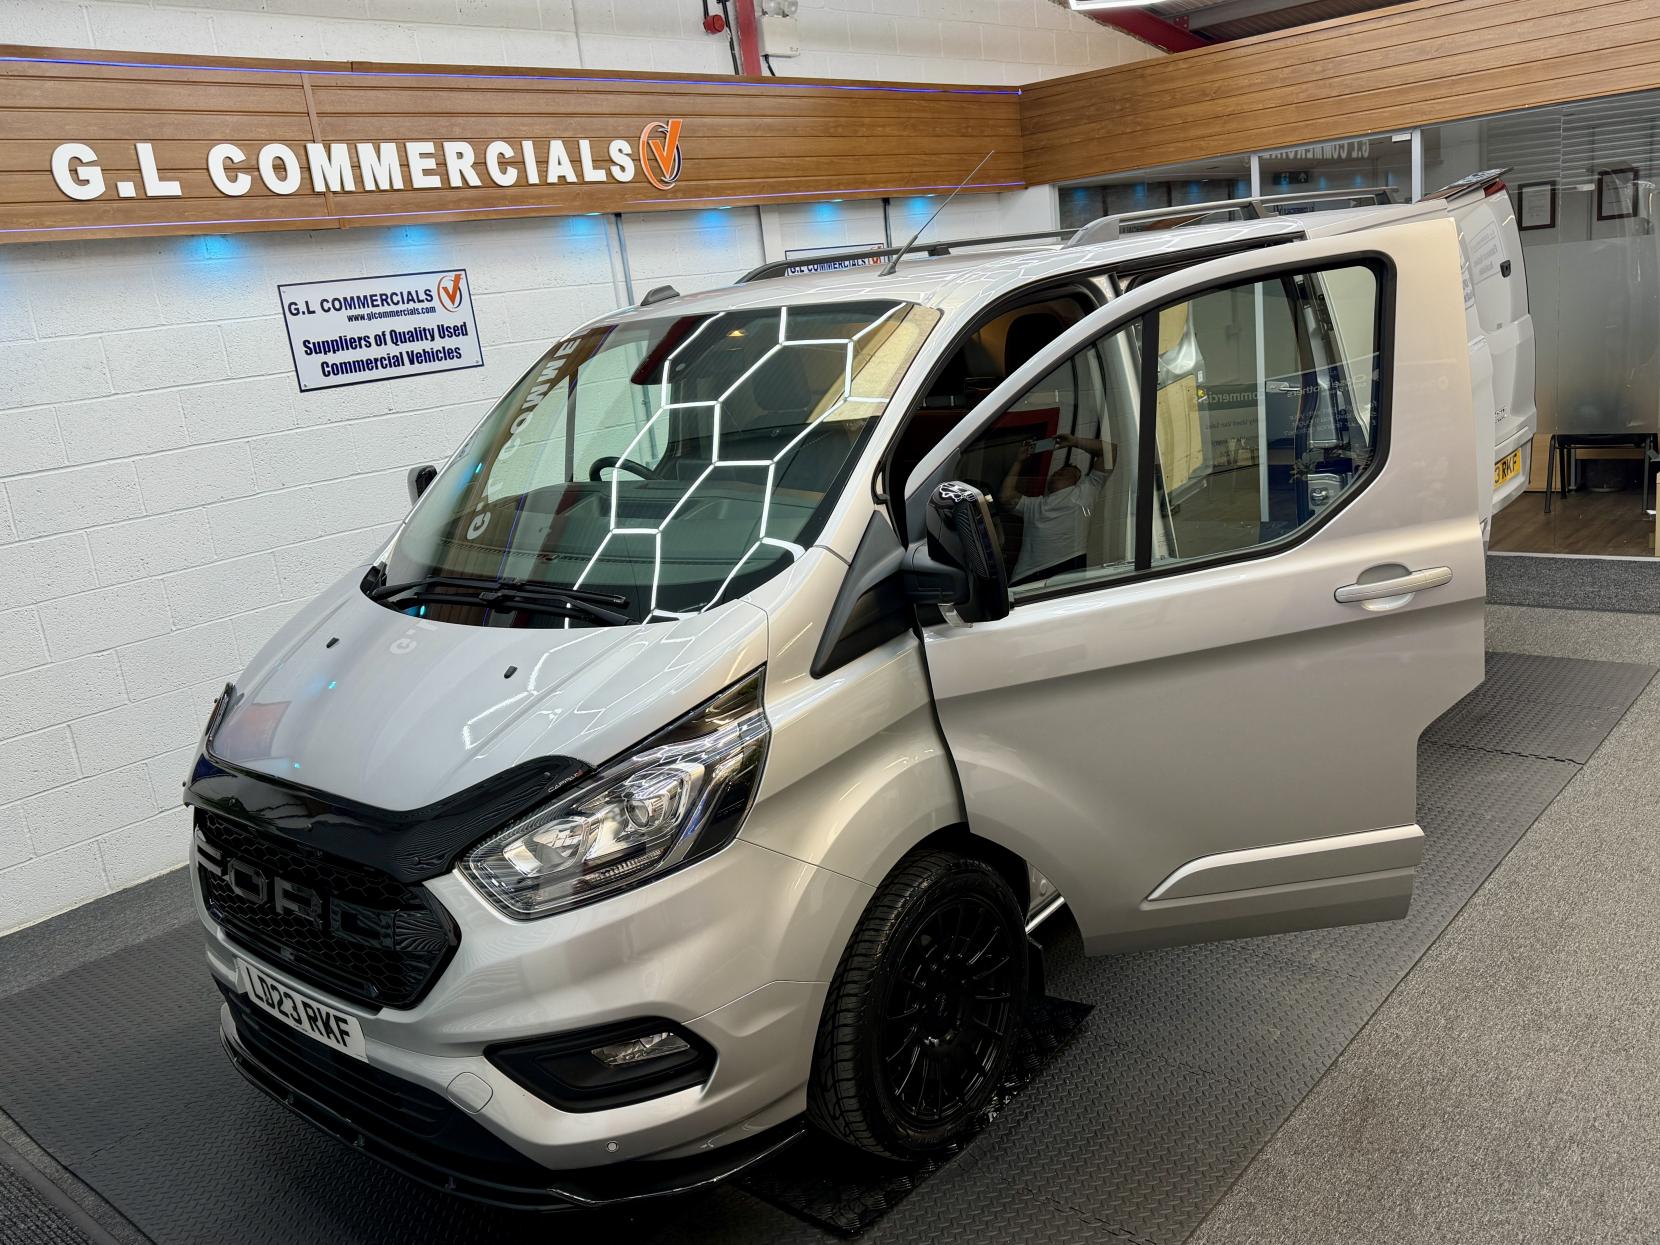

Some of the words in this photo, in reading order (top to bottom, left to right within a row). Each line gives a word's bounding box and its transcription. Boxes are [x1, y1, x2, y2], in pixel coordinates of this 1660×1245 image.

[51, 143, 183, 200] G.L
[207, 139, 636, 197] COMMERCIALS
[287, 300, 316, 317] G.L
[319, 288, 434, 314] COMMERCIALS
[346, 305, 437, 323] www.glcommercials.com
[302, 335, 372, 356] Suppliers
[374, 330, 388, 347] of
[389, 326, 436, 347] Quality
[436, 321, 469, 338] Used
[320, 351, 405, 378] Commercial
[405, 346, 462, 367] Vehicles
[194, 825, 396, 951] FORD
[245, 966, 303, 1027] LD23
[300, 999, 351, 1048] RKF
